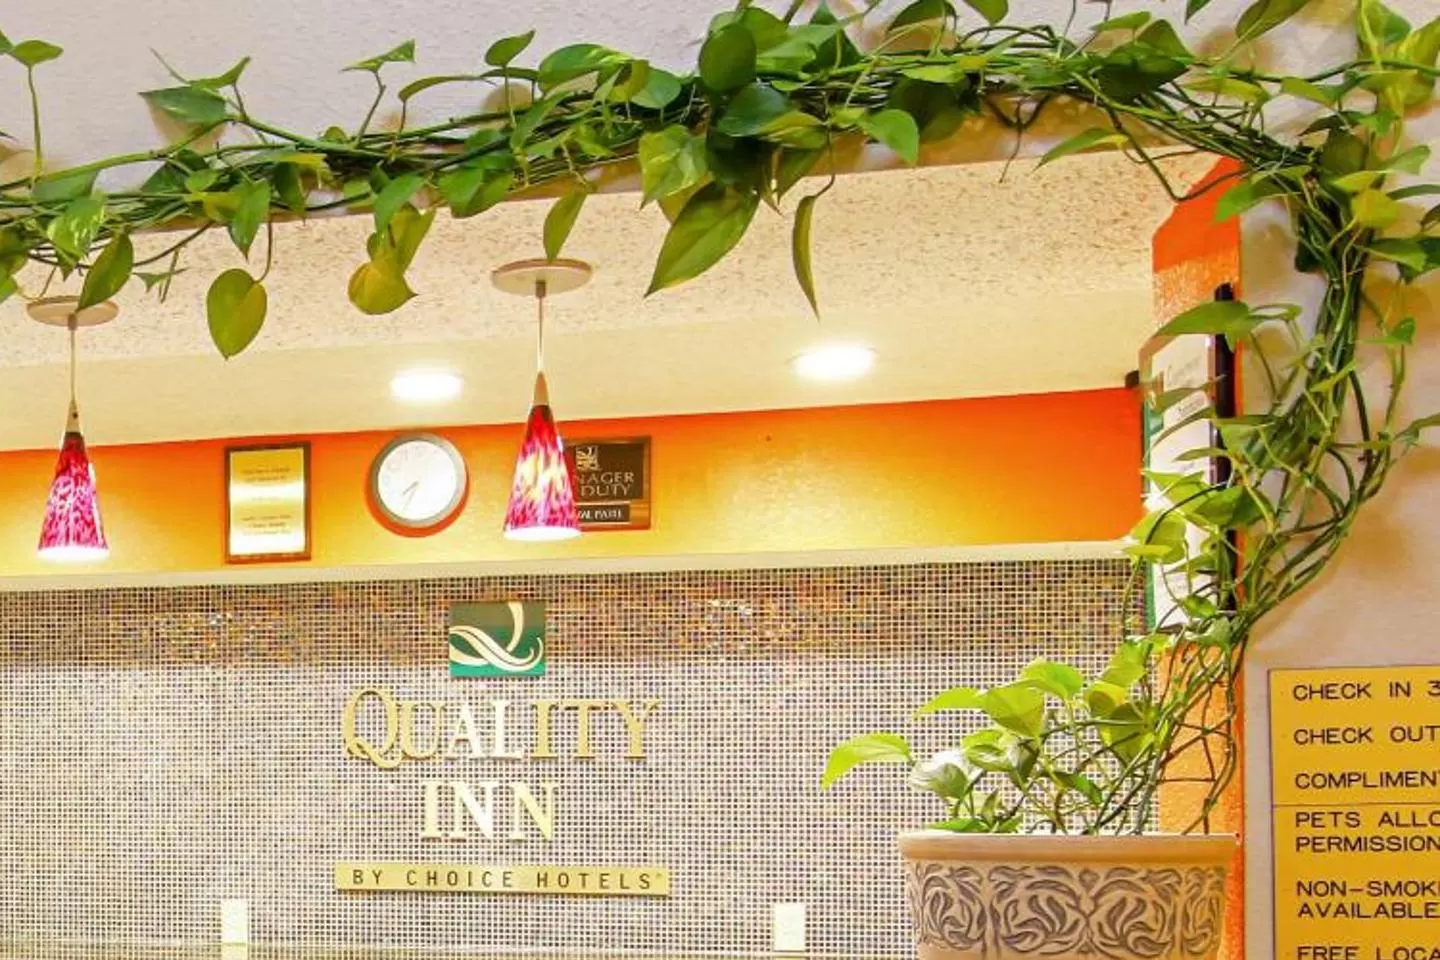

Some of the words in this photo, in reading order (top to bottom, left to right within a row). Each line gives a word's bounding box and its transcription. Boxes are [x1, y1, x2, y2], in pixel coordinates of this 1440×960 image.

[574, 471, 634, 484] NAGER
[580, 483, 632, 497] DUTY
[1293, 682, 1372, 701] CHECK
[1389, 681, 1411, 698] IN
[343, 688, 660, 769] QUALITY
[1293, 726, 1374, 745] CHECK
[1389, 725, 1440, 743] OUT
[1295, 770, 1440, 790] COMPLIMEN
[421, 779, 561, 841] INN
[1295, 811, 1361, 828] PETS
[1295, 835, 1440, 853] PERMISSION
[353, 868, 383, 885] BY
[406, 870, 514, 888] CHOICE
[536, 871, 652, 890] HOTELS
[1297, 902, 1440, 919] AVAILABLE
